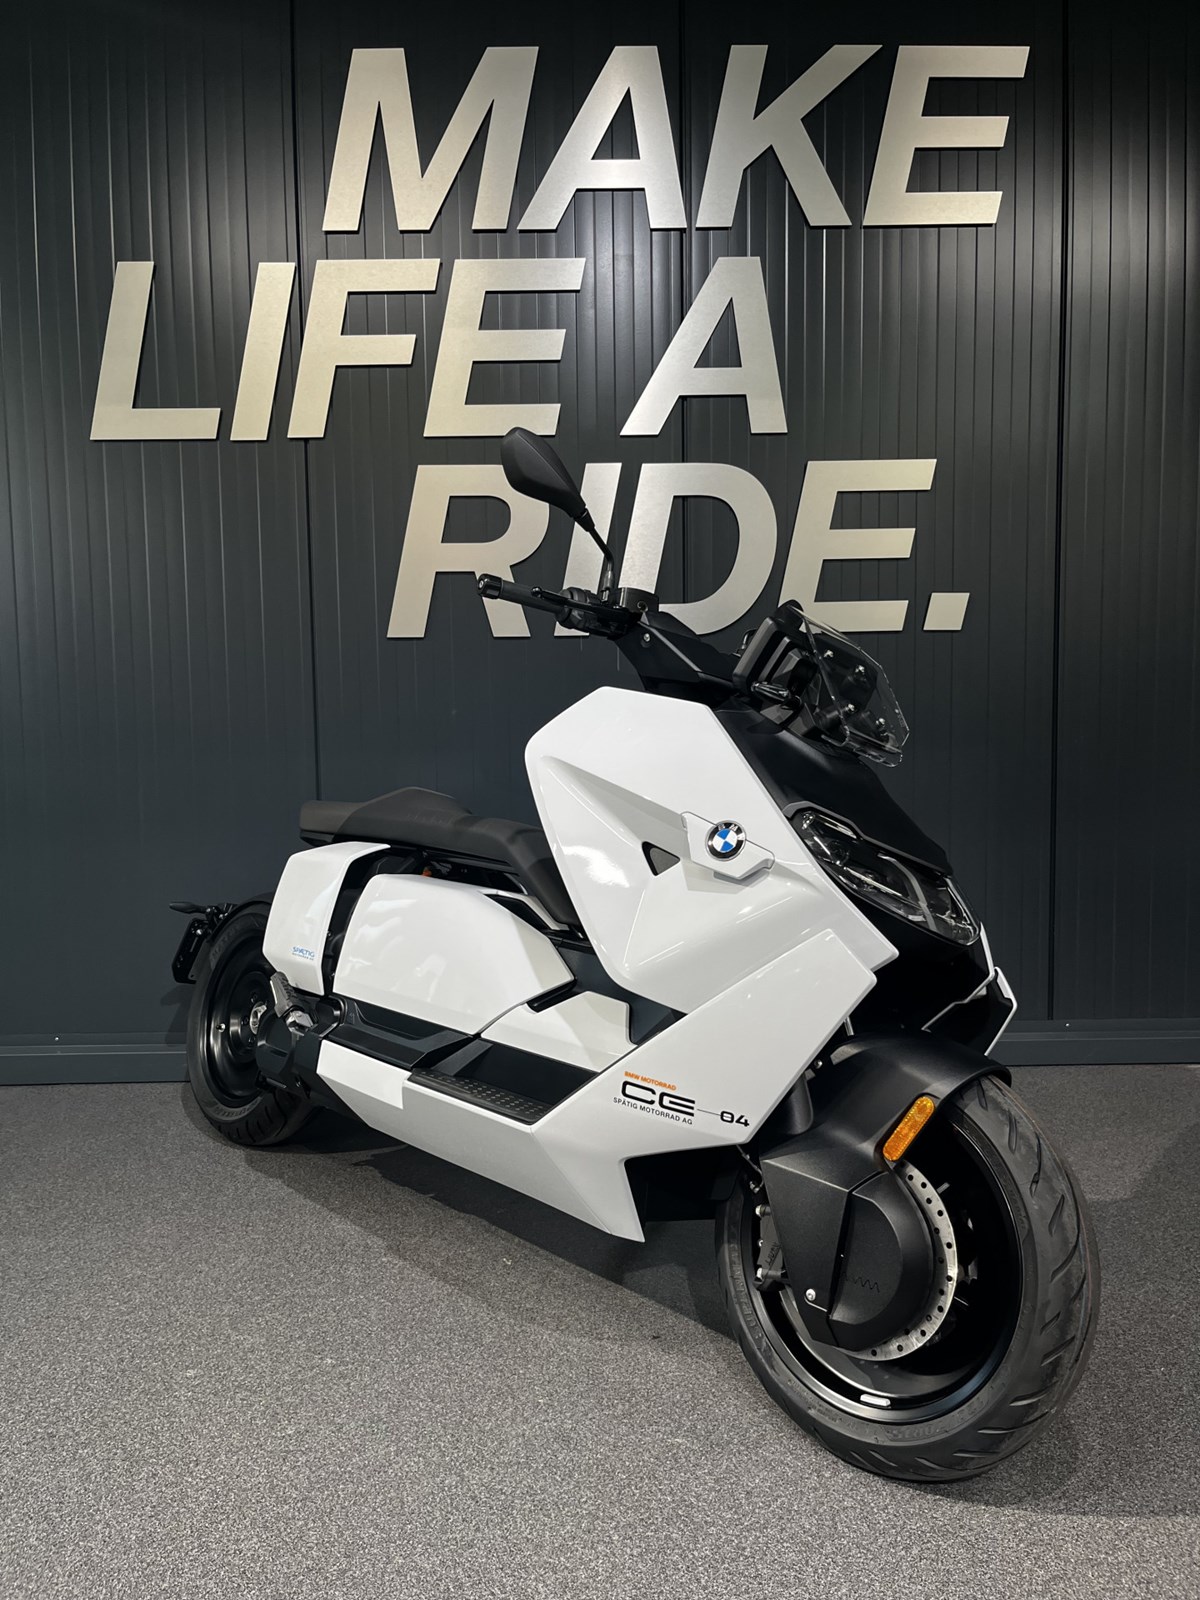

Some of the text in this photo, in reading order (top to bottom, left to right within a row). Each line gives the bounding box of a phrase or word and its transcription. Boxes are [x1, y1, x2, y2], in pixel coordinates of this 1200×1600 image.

[323, 44, 1030, 231] MAKE
[90, 255, 788, 441] LIFE A
[387, 458, 970, 639] RIDE.
[621, 1080, 696, 1117] CE
[624, 1071, 677, 1091] BMW MOTORRAD
[639, 1104, 680, 1122] MOTORRAD
[681, 1115, 693, 1125] AG
